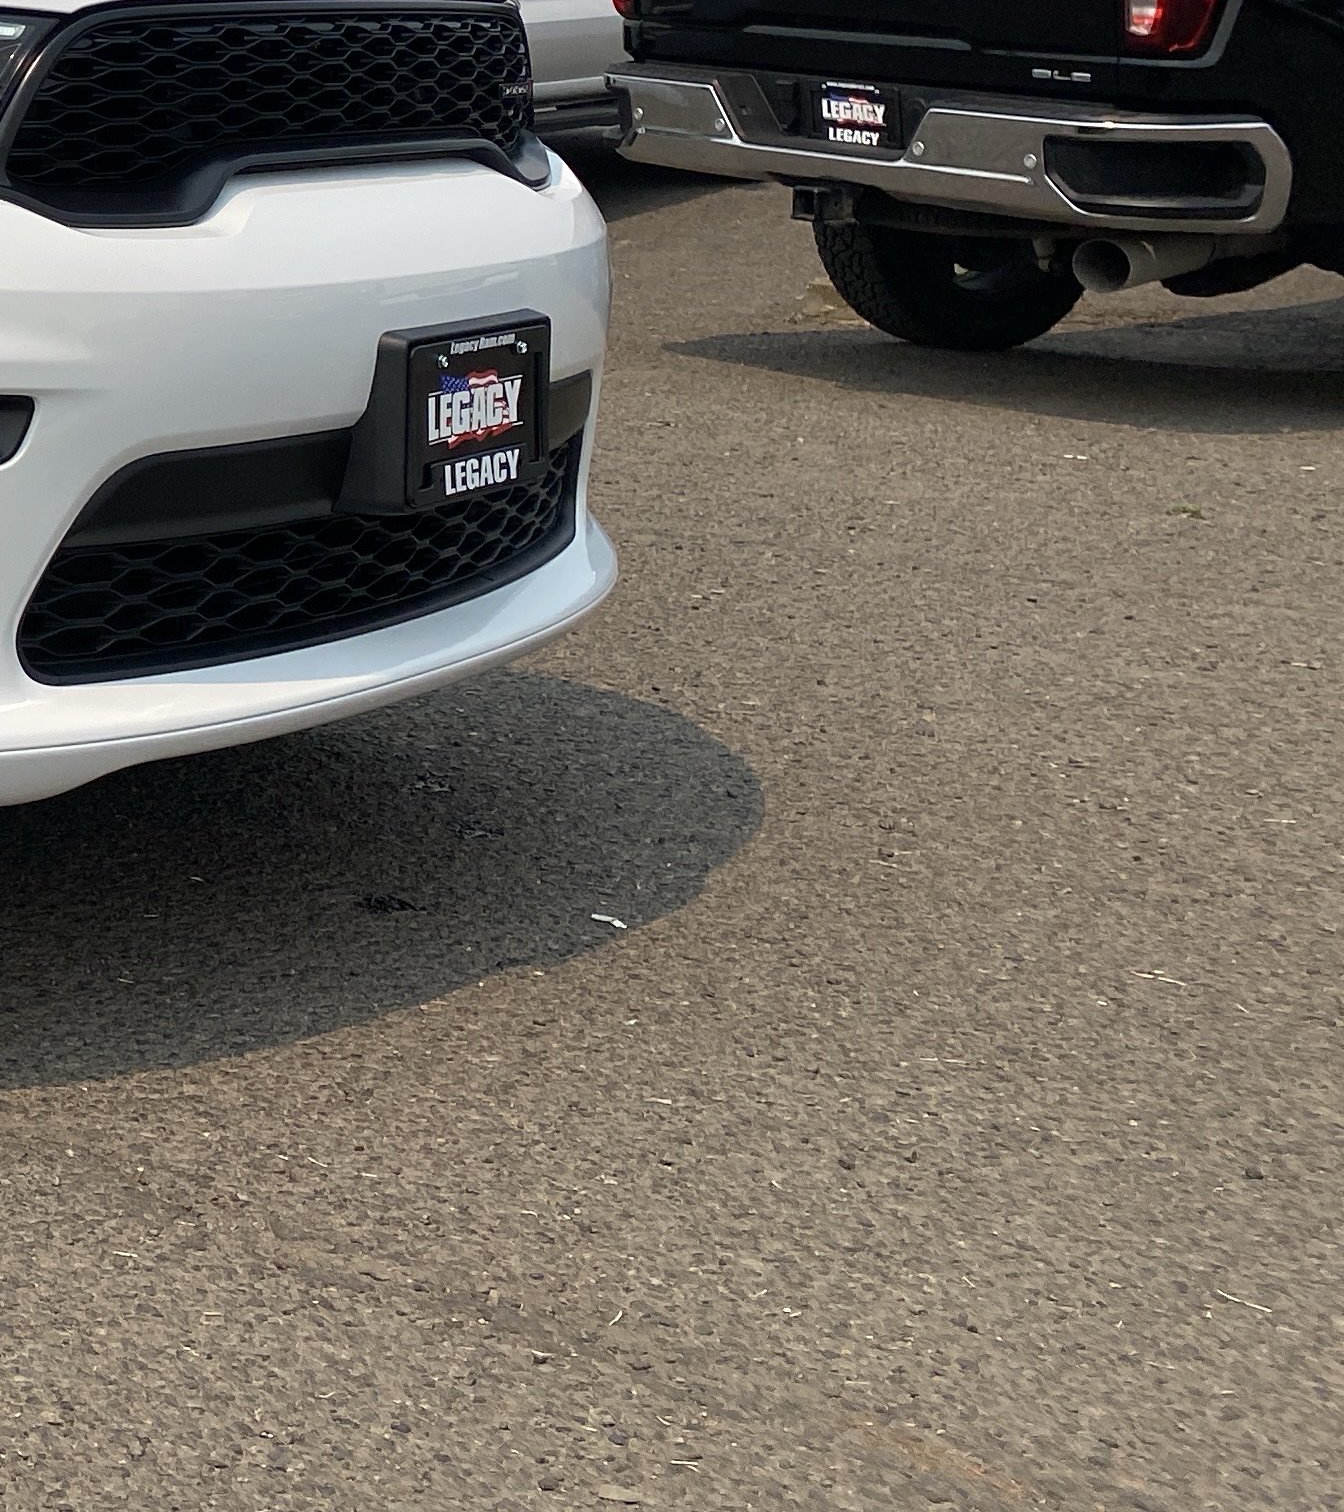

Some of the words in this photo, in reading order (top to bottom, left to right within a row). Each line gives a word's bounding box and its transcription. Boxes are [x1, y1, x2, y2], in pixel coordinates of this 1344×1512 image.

[821, 97, 886, 124] LEGACY
[828, 126, 879, 146] LEGACY
[428, 378, 522, 442] LEGACY
[444, 448, 520, 496] LEGACY
